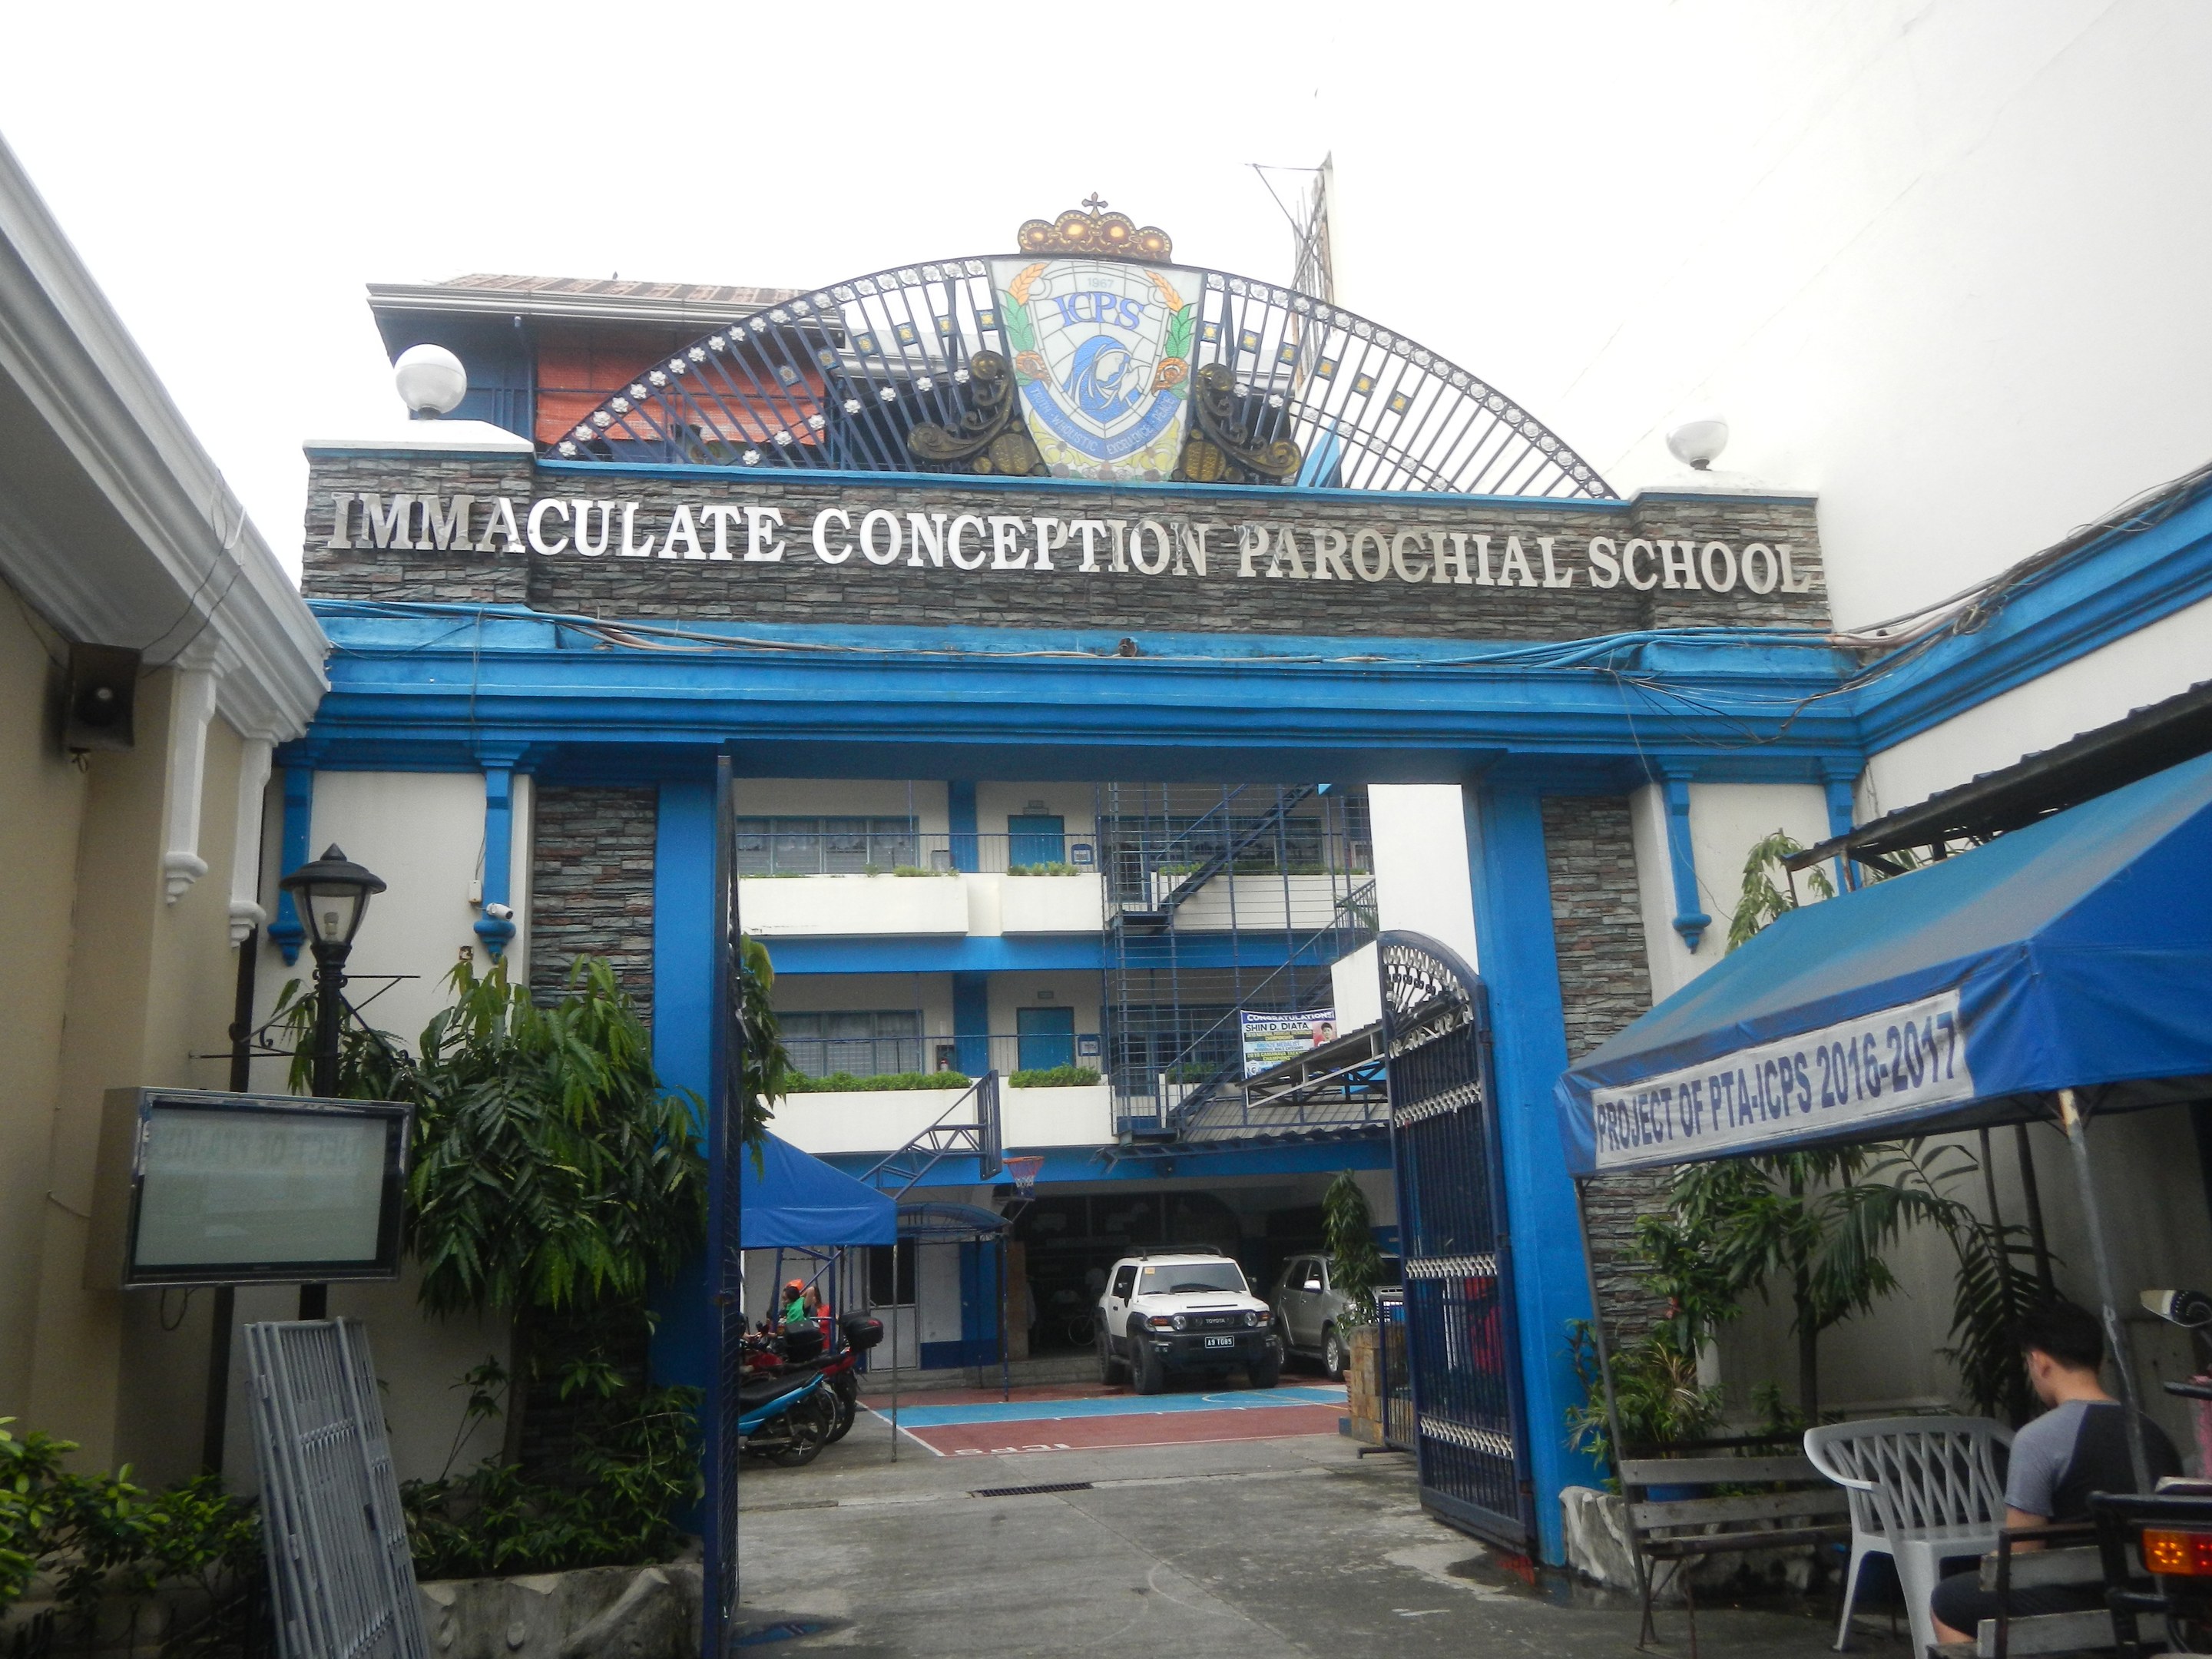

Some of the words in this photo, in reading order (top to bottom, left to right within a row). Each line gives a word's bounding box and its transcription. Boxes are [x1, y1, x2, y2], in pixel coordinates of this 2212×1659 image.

[1088, 277, 1114, 288] 1967
[1052, 291, 1145, 330] ICPS
[1052, 415, 1098, 452] WHOLISTIC
[327, 492, 786, 562] IMMACULATE
[811, 508, 1209, 578] CONCEPTION
[1234, 523, 1574, 589] PAROCHIAL
[1588, 535, 1811, 595] SCHOOL
[1247, 1011, 1335, 1022] CONGRATULATIONS!
[1596, 1087, 1673, 1153] PROJECT
[1679, 1079, 1704, 1137] OF
[1709, 1051, 1812, 1131] PTA-ICPS
[1816, 1011, 1956, 1108] 2016-2017
